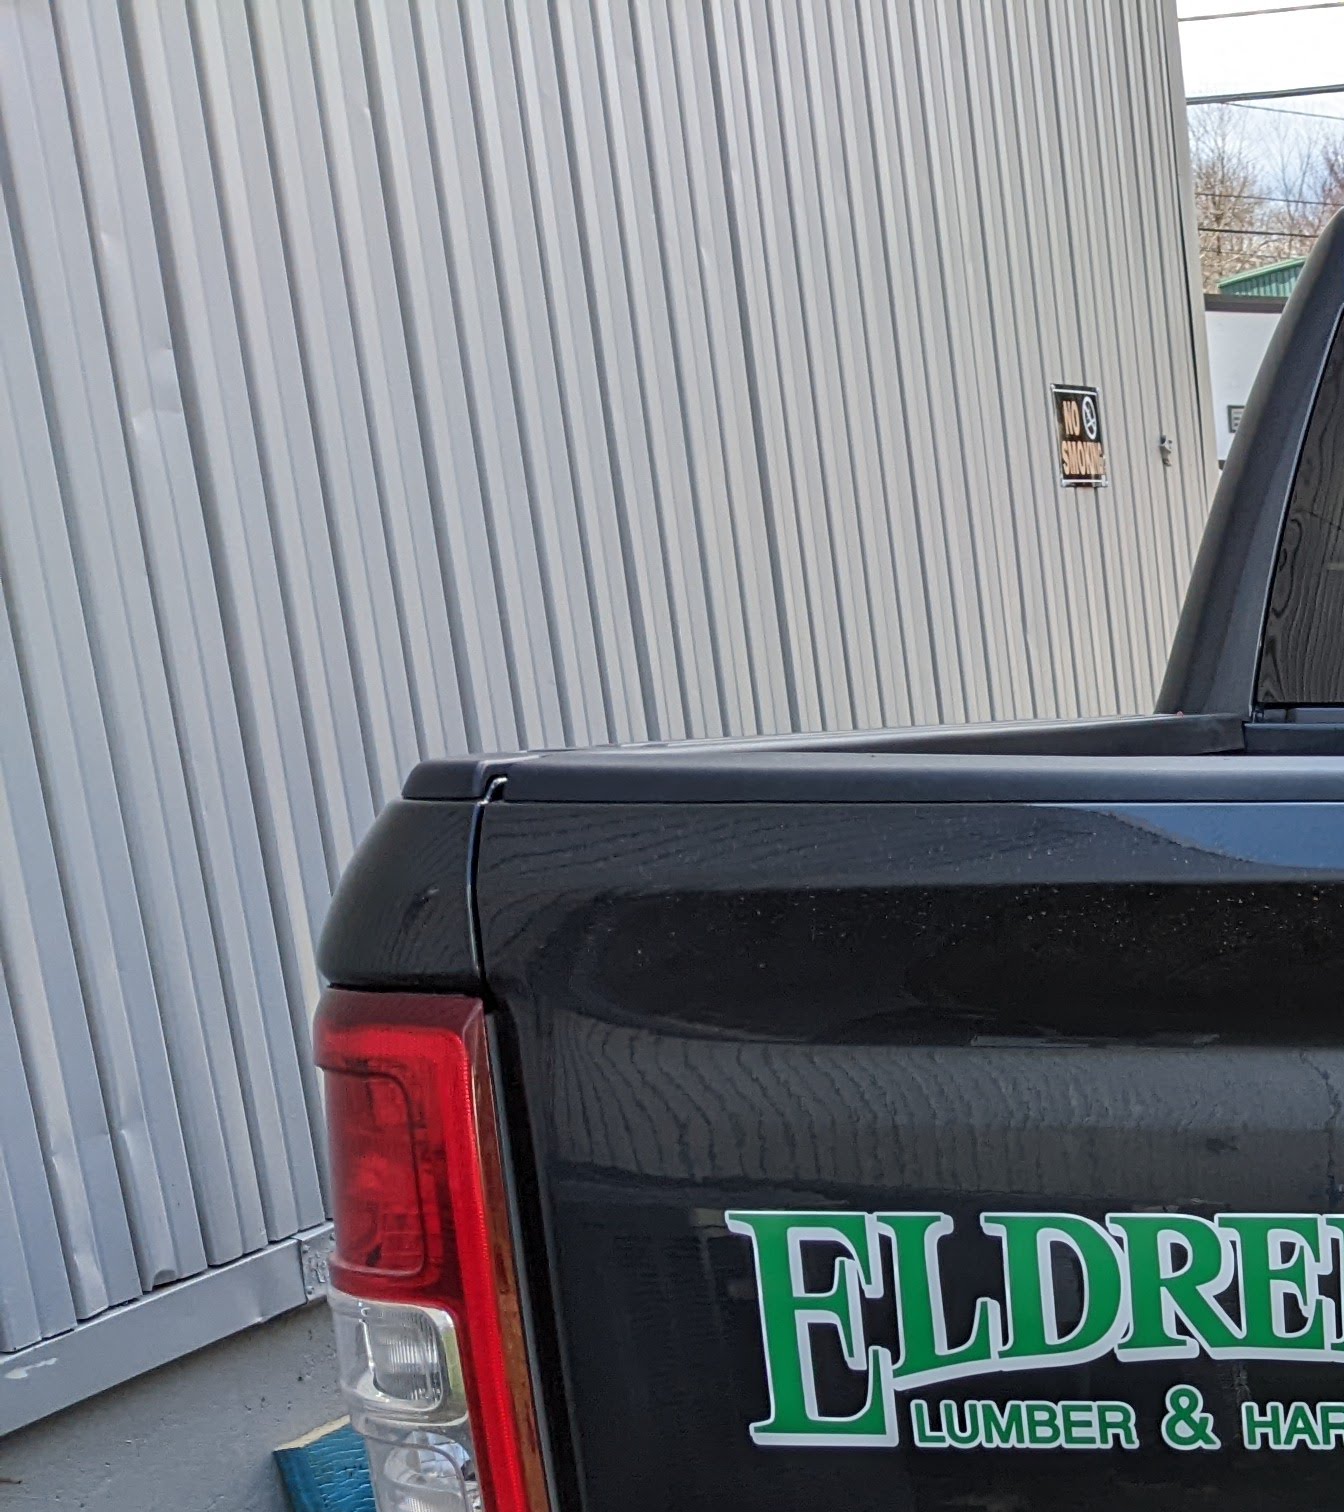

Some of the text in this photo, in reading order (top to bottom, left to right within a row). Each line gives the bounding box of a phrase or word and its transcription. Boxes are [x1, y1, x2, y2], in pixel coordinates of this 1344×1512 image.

[1062, 400, 1081, 436] NO
[910, 1399, 1138, 1449] LUMBER
[1160, 1383, 1221, 1450] &
